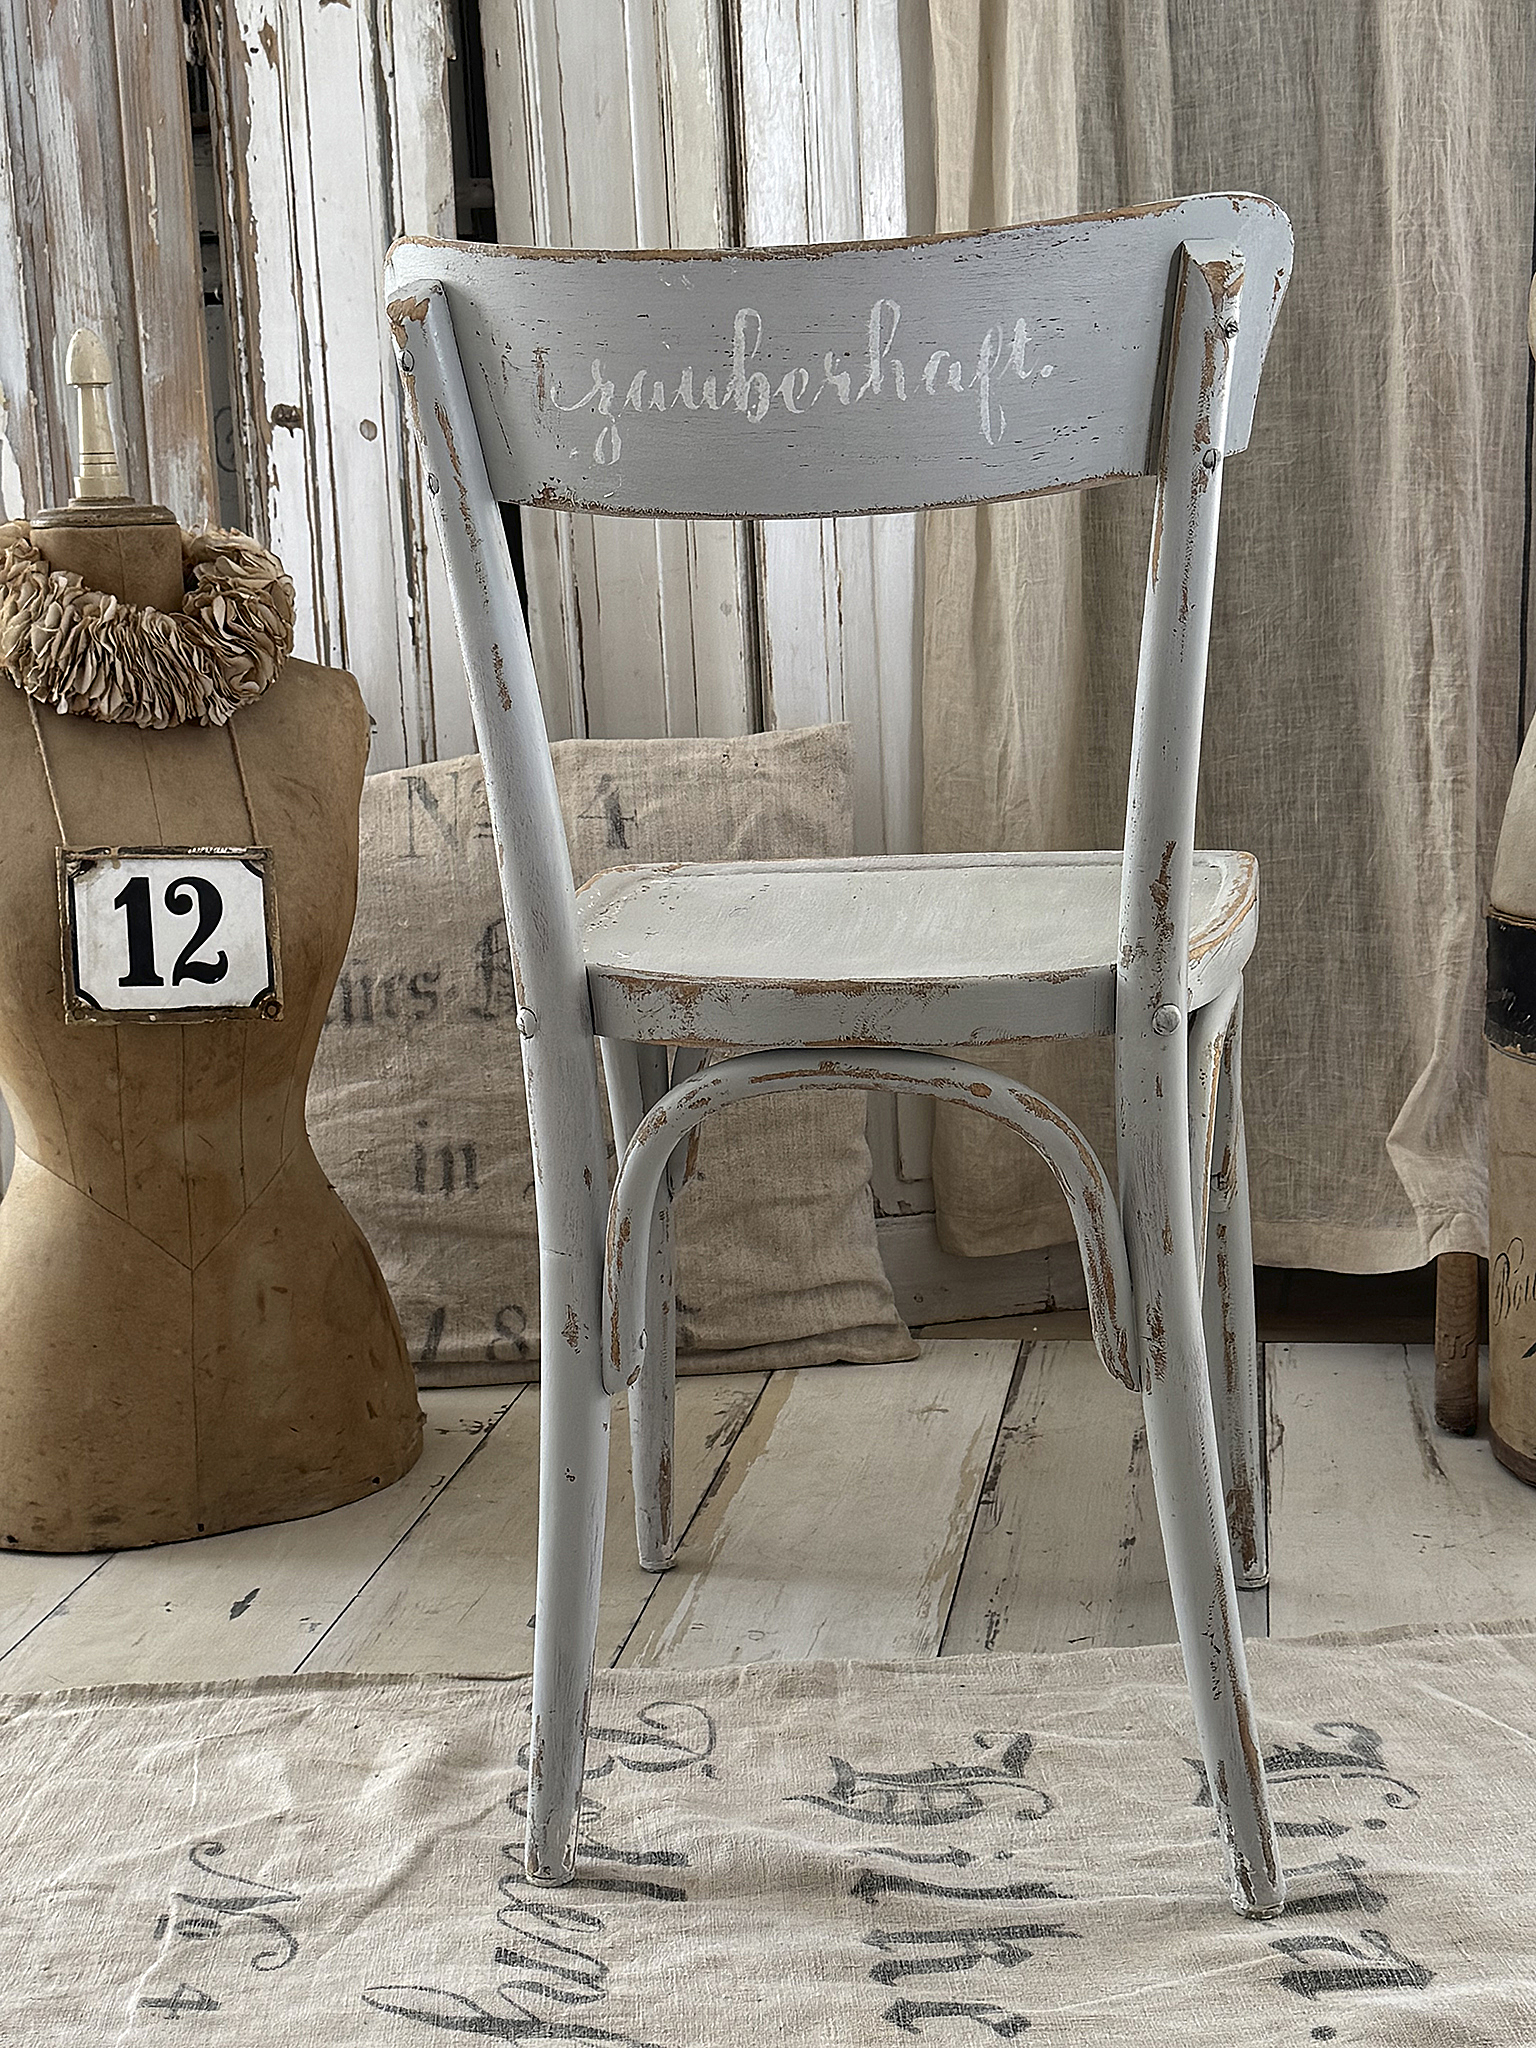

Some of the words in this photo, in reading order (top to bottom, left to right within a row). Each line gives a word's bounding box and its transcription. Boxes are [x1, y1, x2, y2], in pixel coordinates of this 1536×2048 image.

[550, 298, 1054, 466] zauberhaft.
[577, 773, 638, 851] 4
[114, 876, 229, 988] 12
